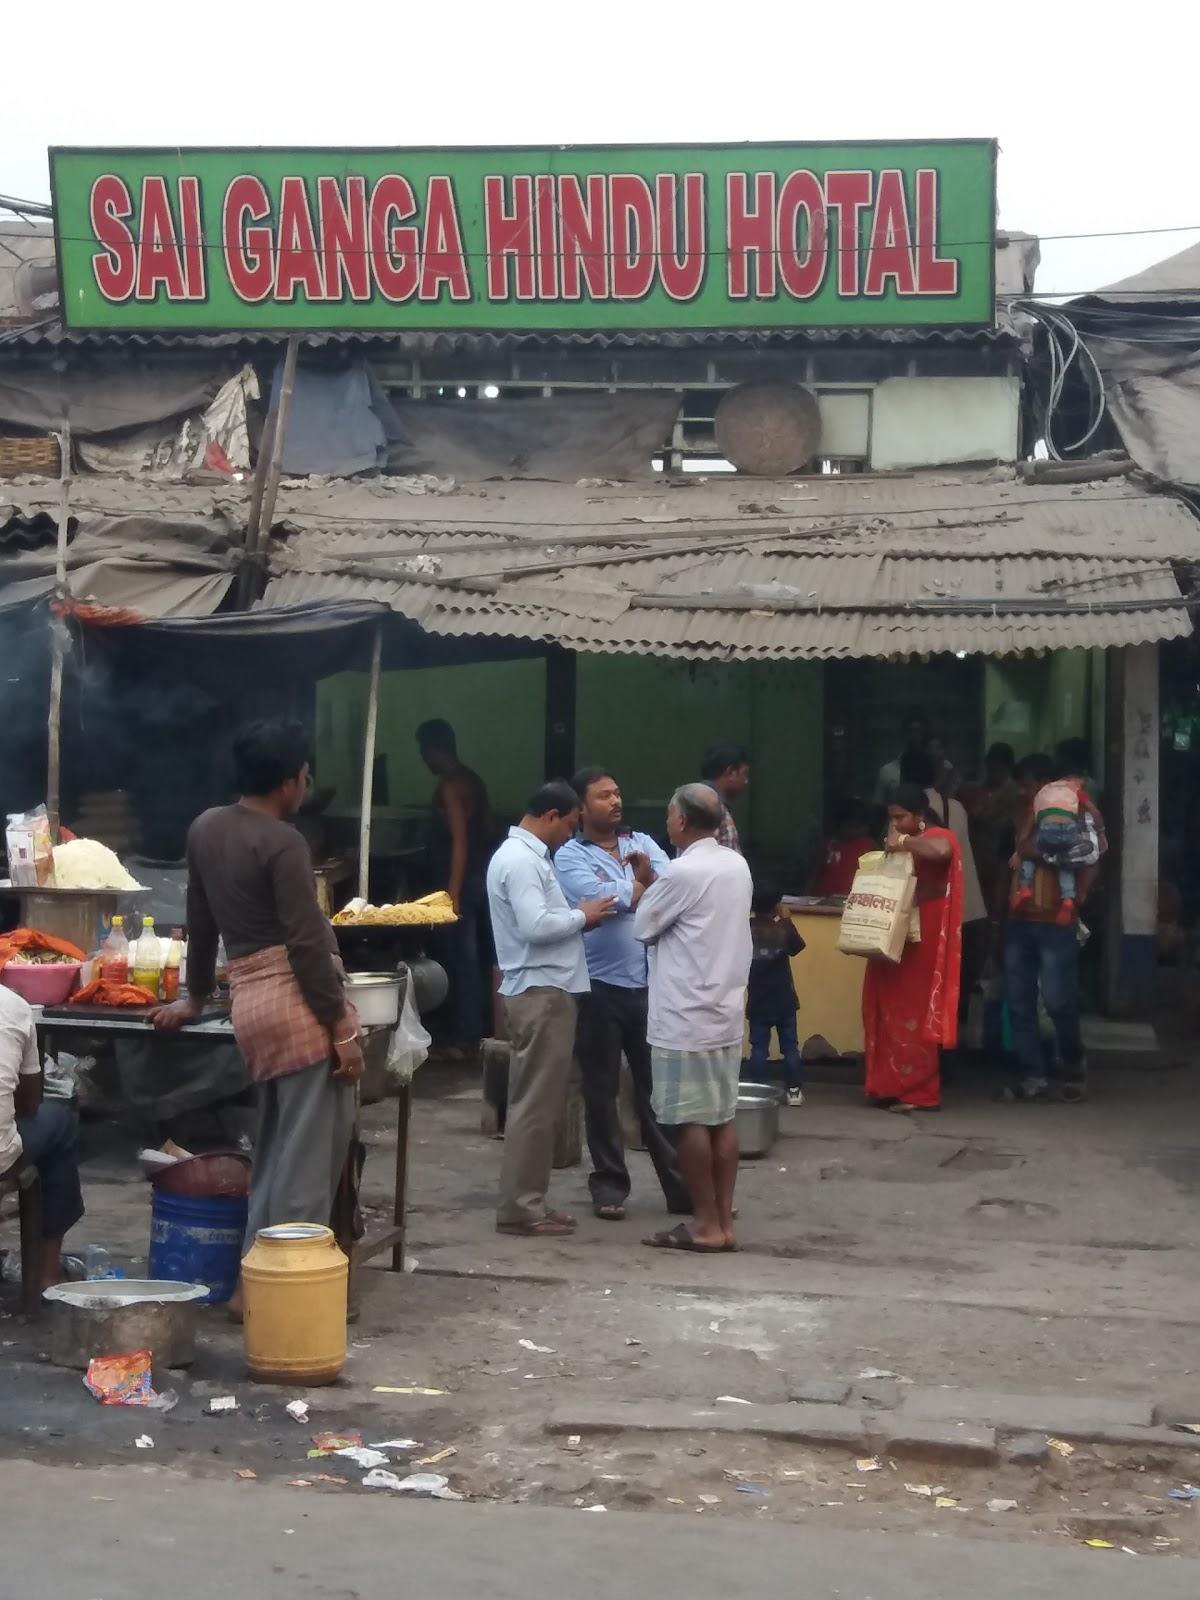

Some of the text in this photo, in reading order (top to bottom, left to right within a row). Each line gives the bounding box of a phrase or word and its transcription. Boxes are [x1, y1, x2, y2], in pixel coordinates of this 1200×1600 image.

[90, 169, 958, 302] SAI GANGA HINDU HOTAL
